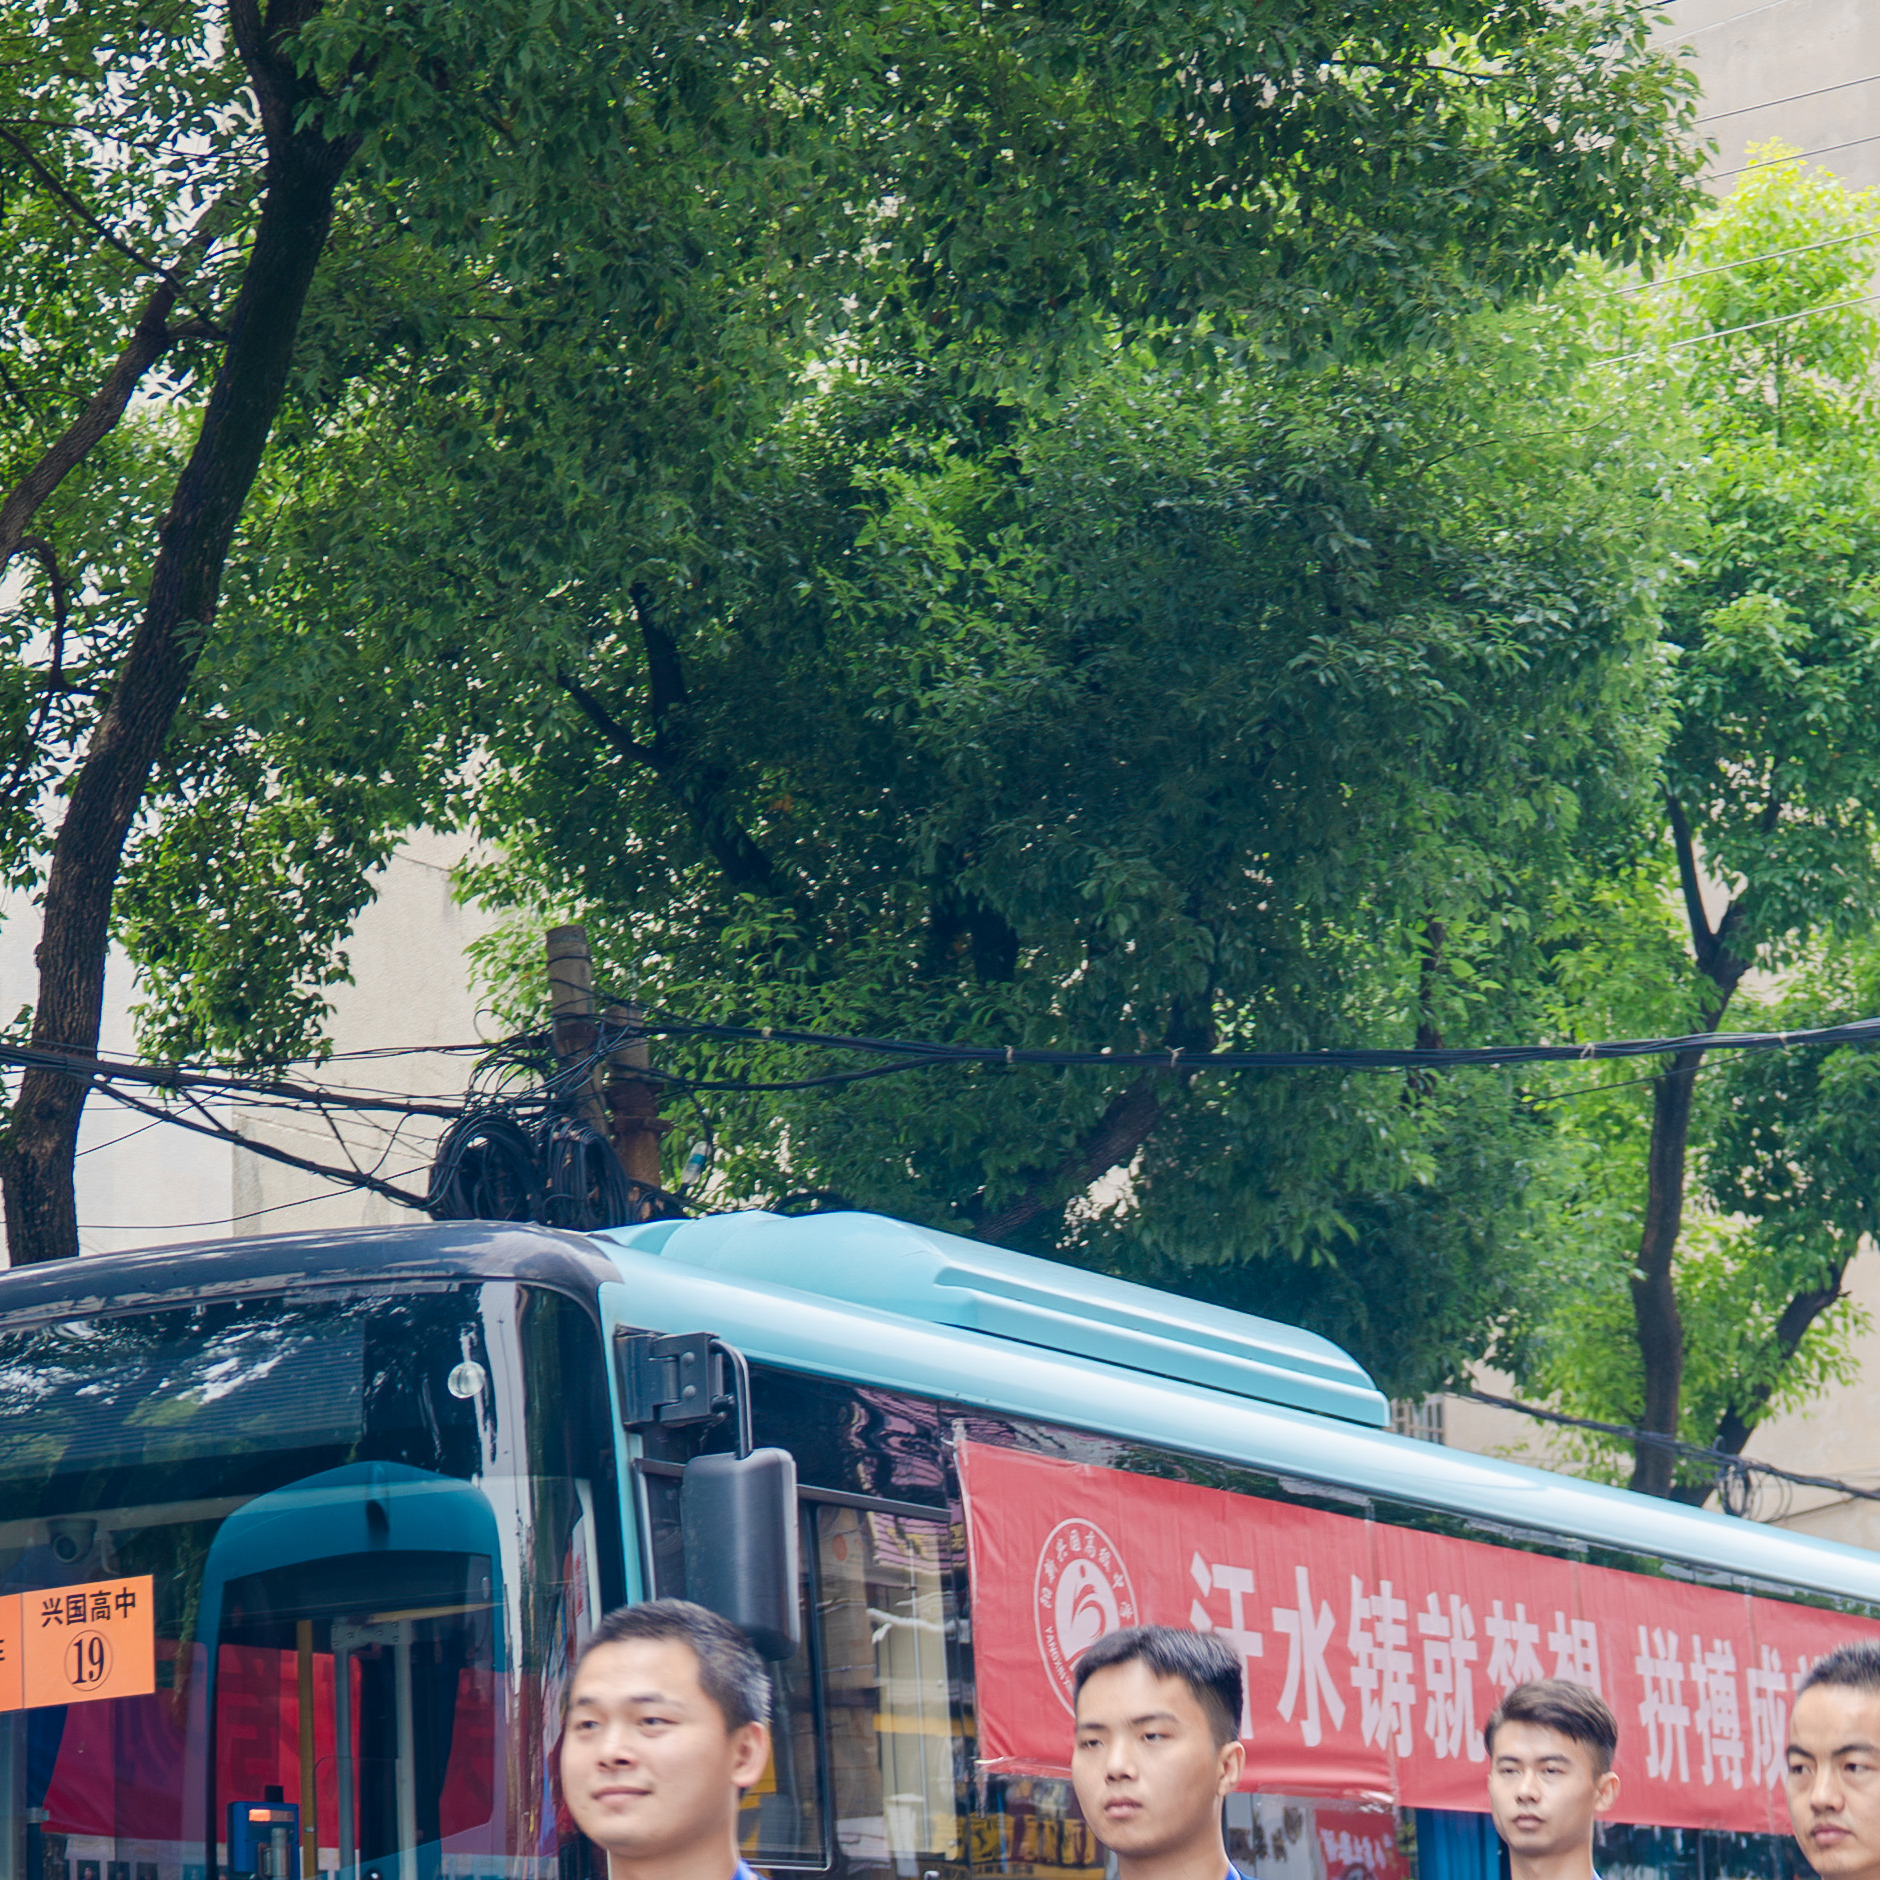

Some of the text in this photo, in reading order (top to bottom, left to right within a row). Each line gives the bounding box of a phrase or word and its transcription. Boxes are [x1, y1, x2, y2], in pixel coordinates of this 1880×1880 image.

[41, 1586, 137, 1628] 兴国高中
[72, 1636, 104, 1685] 19
[1634, 1625, 1819, 1790] 拼搏成
